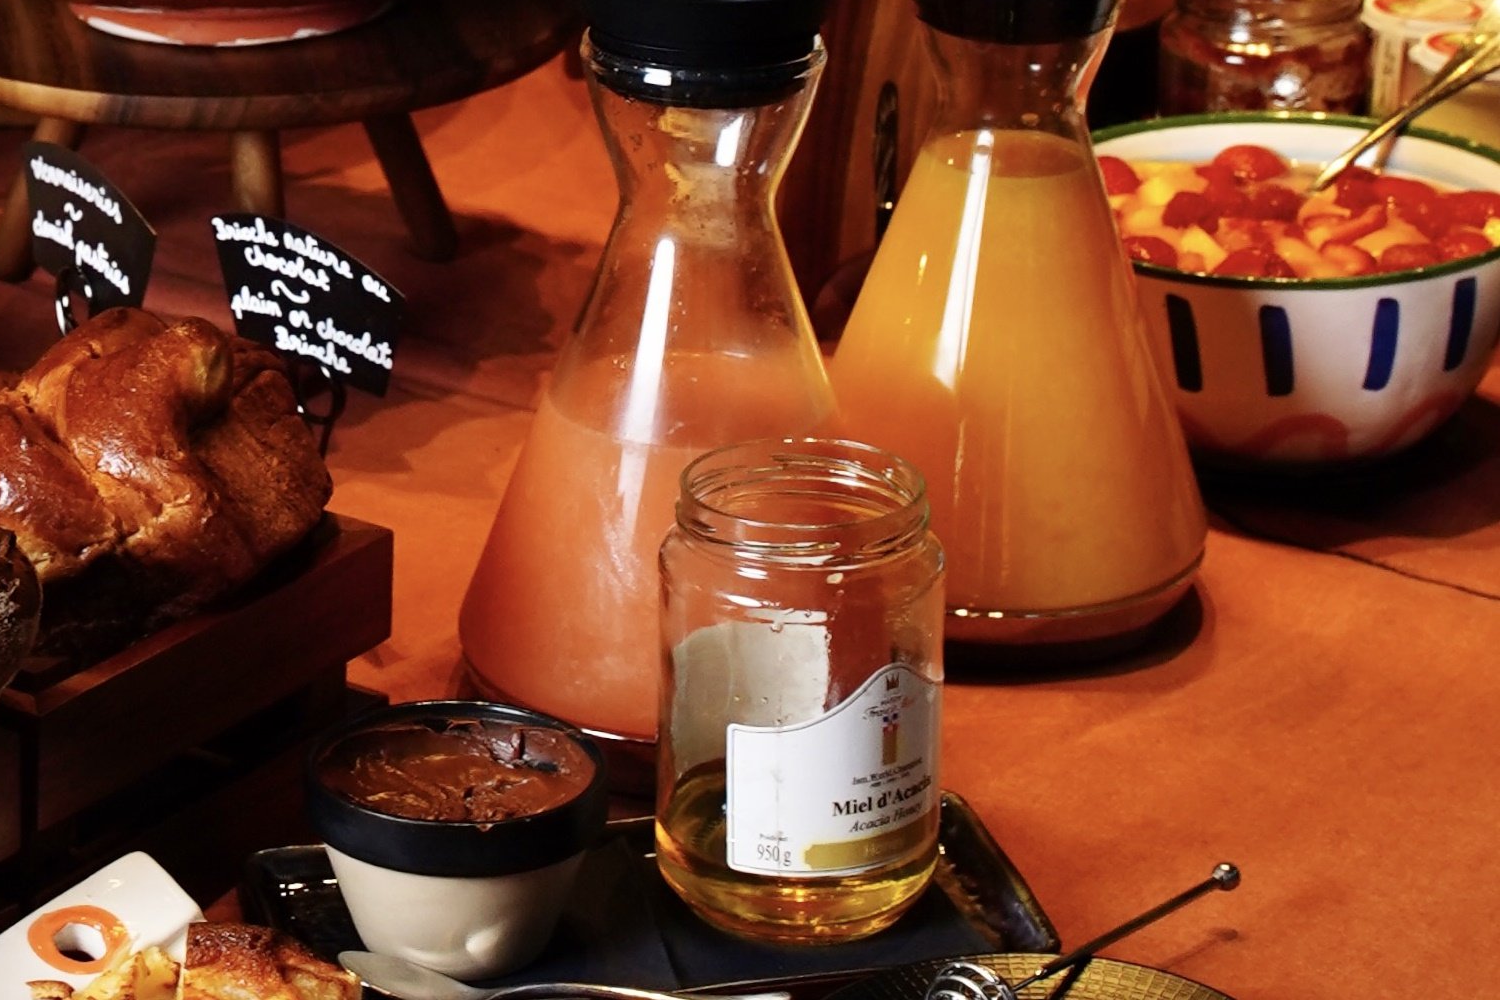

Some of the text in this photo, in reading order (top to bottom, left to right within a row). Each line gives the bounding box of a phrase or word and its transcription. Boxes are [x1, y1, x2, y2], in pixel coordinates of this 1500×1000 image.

[231, 285, 282, 319] plain
[832, 796, 872, 816] Miel
[849, 815, 890, 833] Acacia
[757, 843, 780, 863] 950
